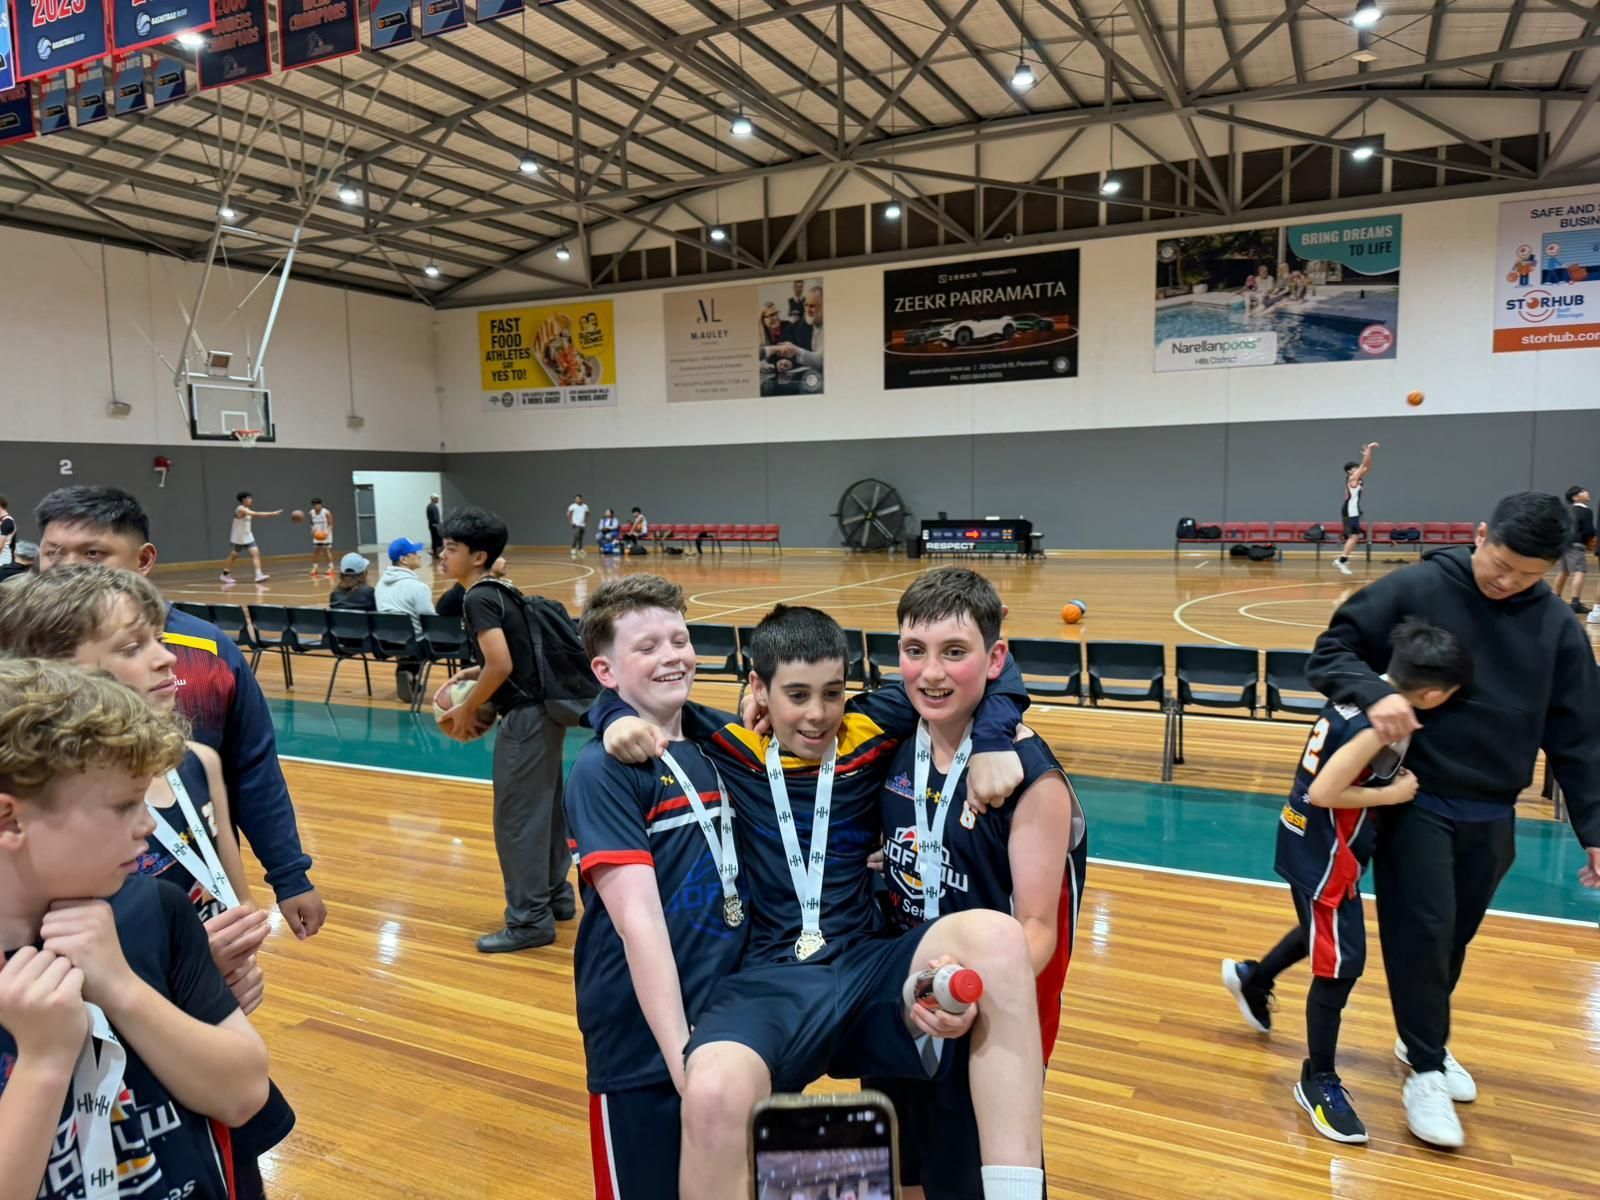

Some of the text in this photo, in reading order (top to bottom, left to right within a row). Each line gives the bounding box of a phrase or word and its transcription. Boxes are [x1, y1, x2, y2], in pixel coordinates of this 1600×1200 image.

[1530, 203, 1596, 219] SAFE AND
[1301, 225, 1393, 246] BRING DREAMS
[1349, 241, 1392, 257] TO LIFE
[894, 281, 1067, 313] ZEEKR PARRAMATTA
[1506, 294, 1584, 310] STORHUB
[490, 317, 521, 334] FAST
[491, 333, 522, 350] FOOD
[486, 347, 531, 362] ATHLETES
[491, 369, 527, 382] YES TO!
[59, 459, 73, 475] 2
[926, 542, 976, 550] RESPECT
[1302, 717, 1330, 775] 2
